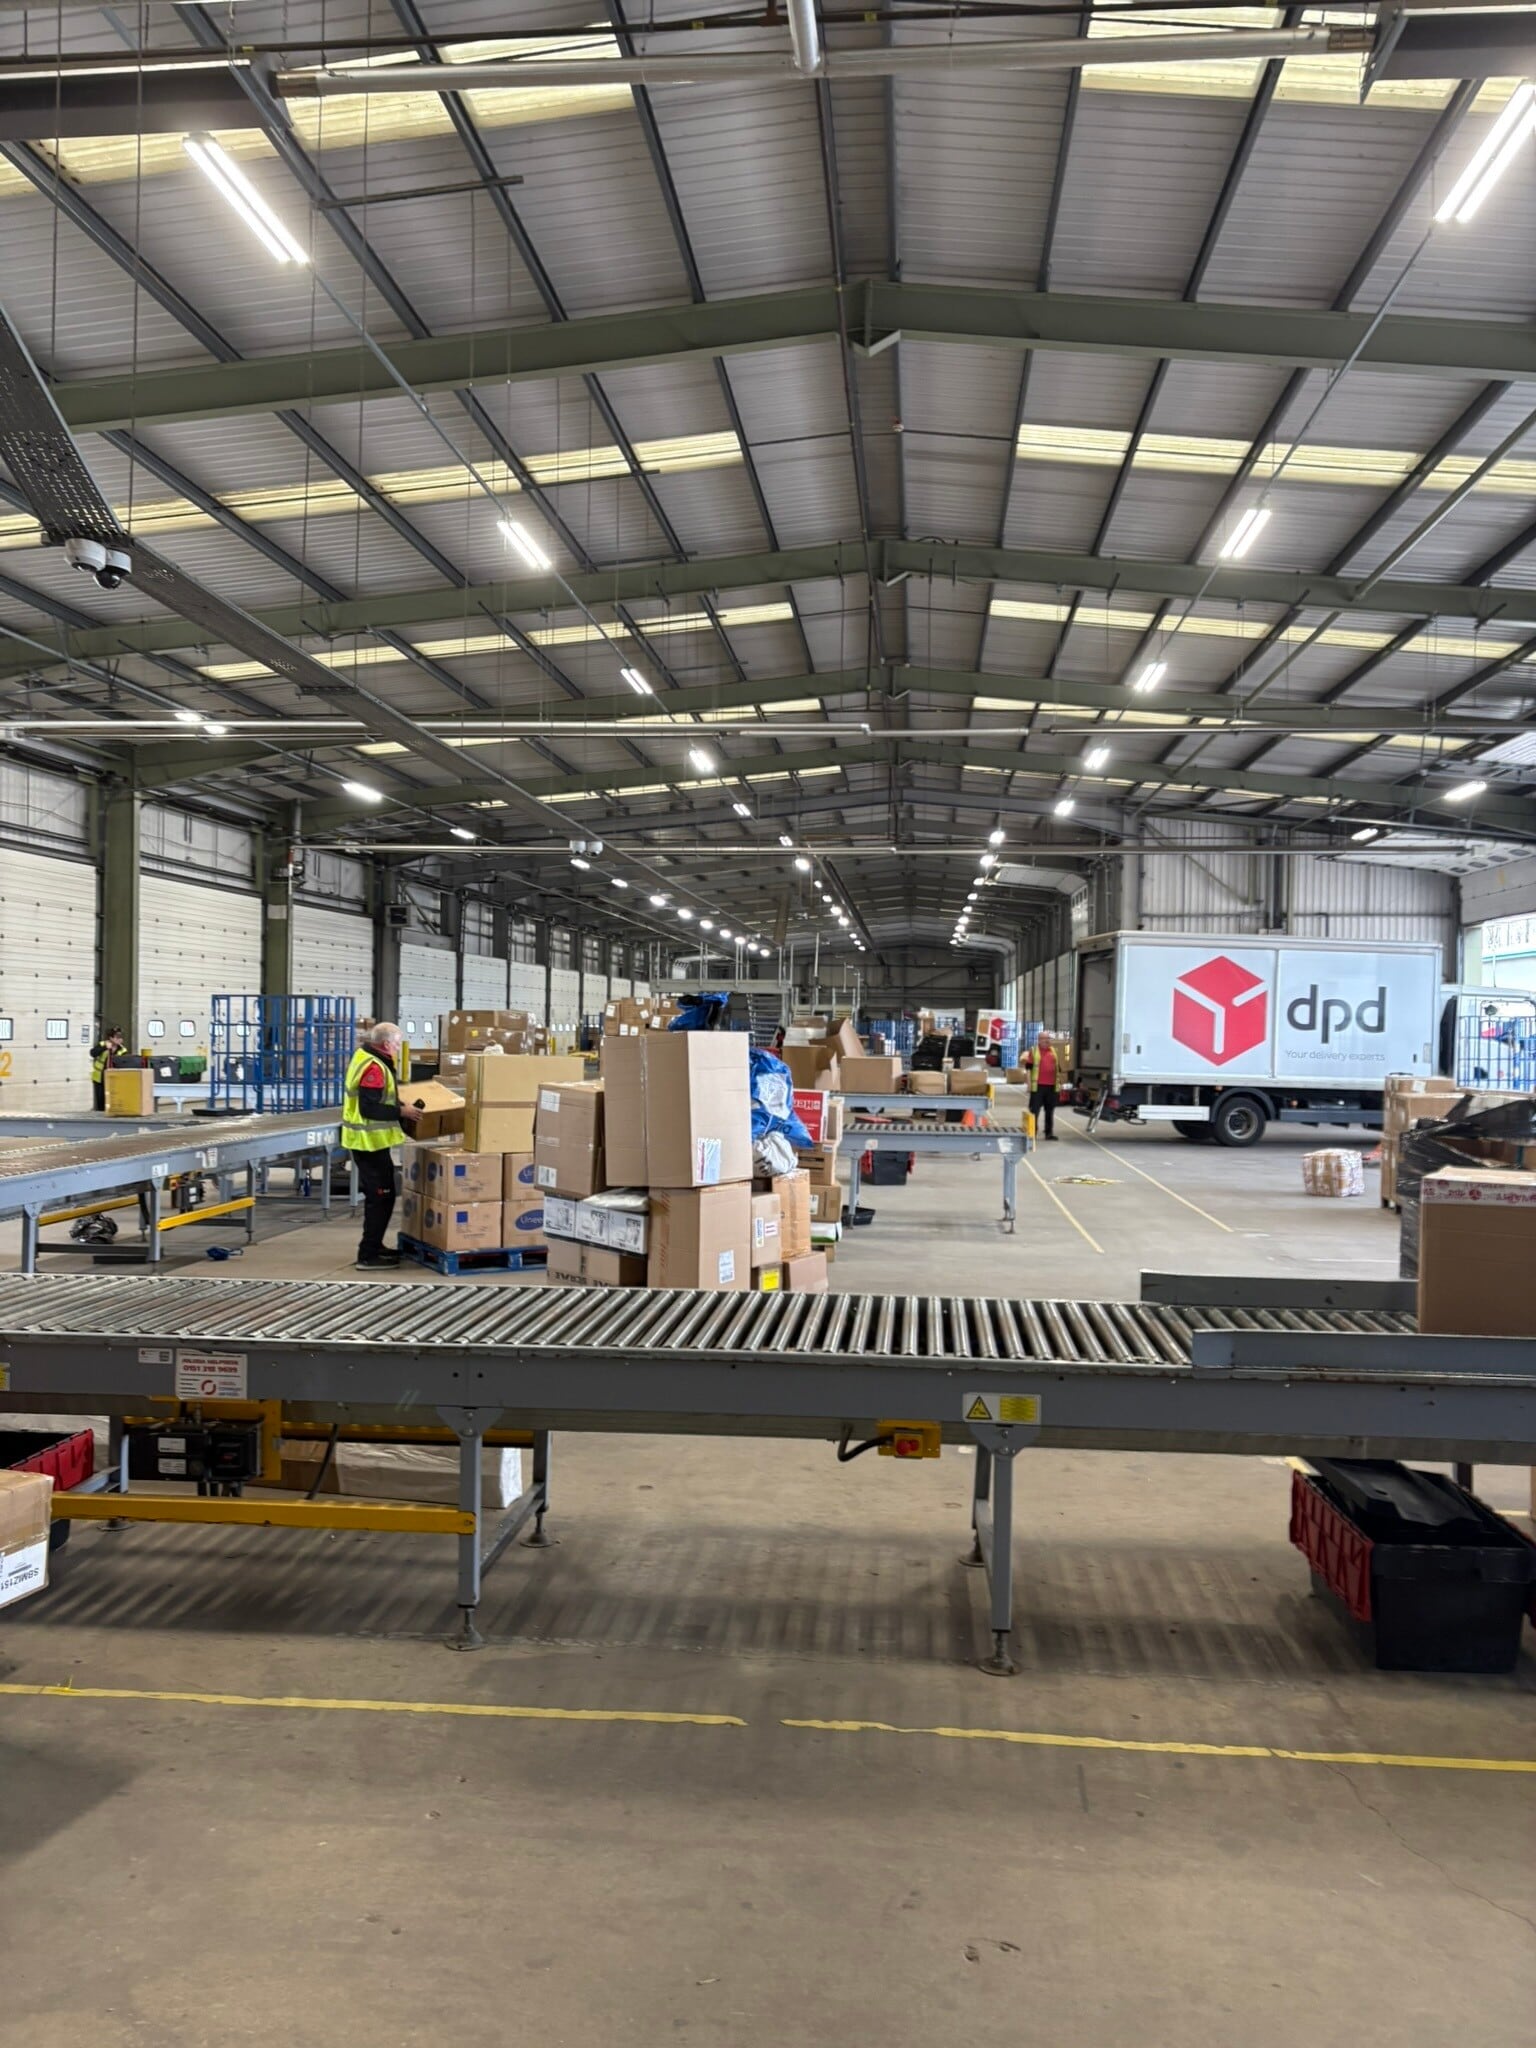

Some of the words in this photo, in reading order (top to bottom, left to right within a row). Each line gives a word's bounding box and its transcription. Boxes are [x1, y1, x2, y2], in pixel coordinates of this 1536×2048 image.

[1286, 984, 1387, 1044] dpd
[1286, 1050, 1308, 1060] Your
[1309, 1050, 1347, 1061] delivery
[1349, 1052, 1386, 1062] experts
